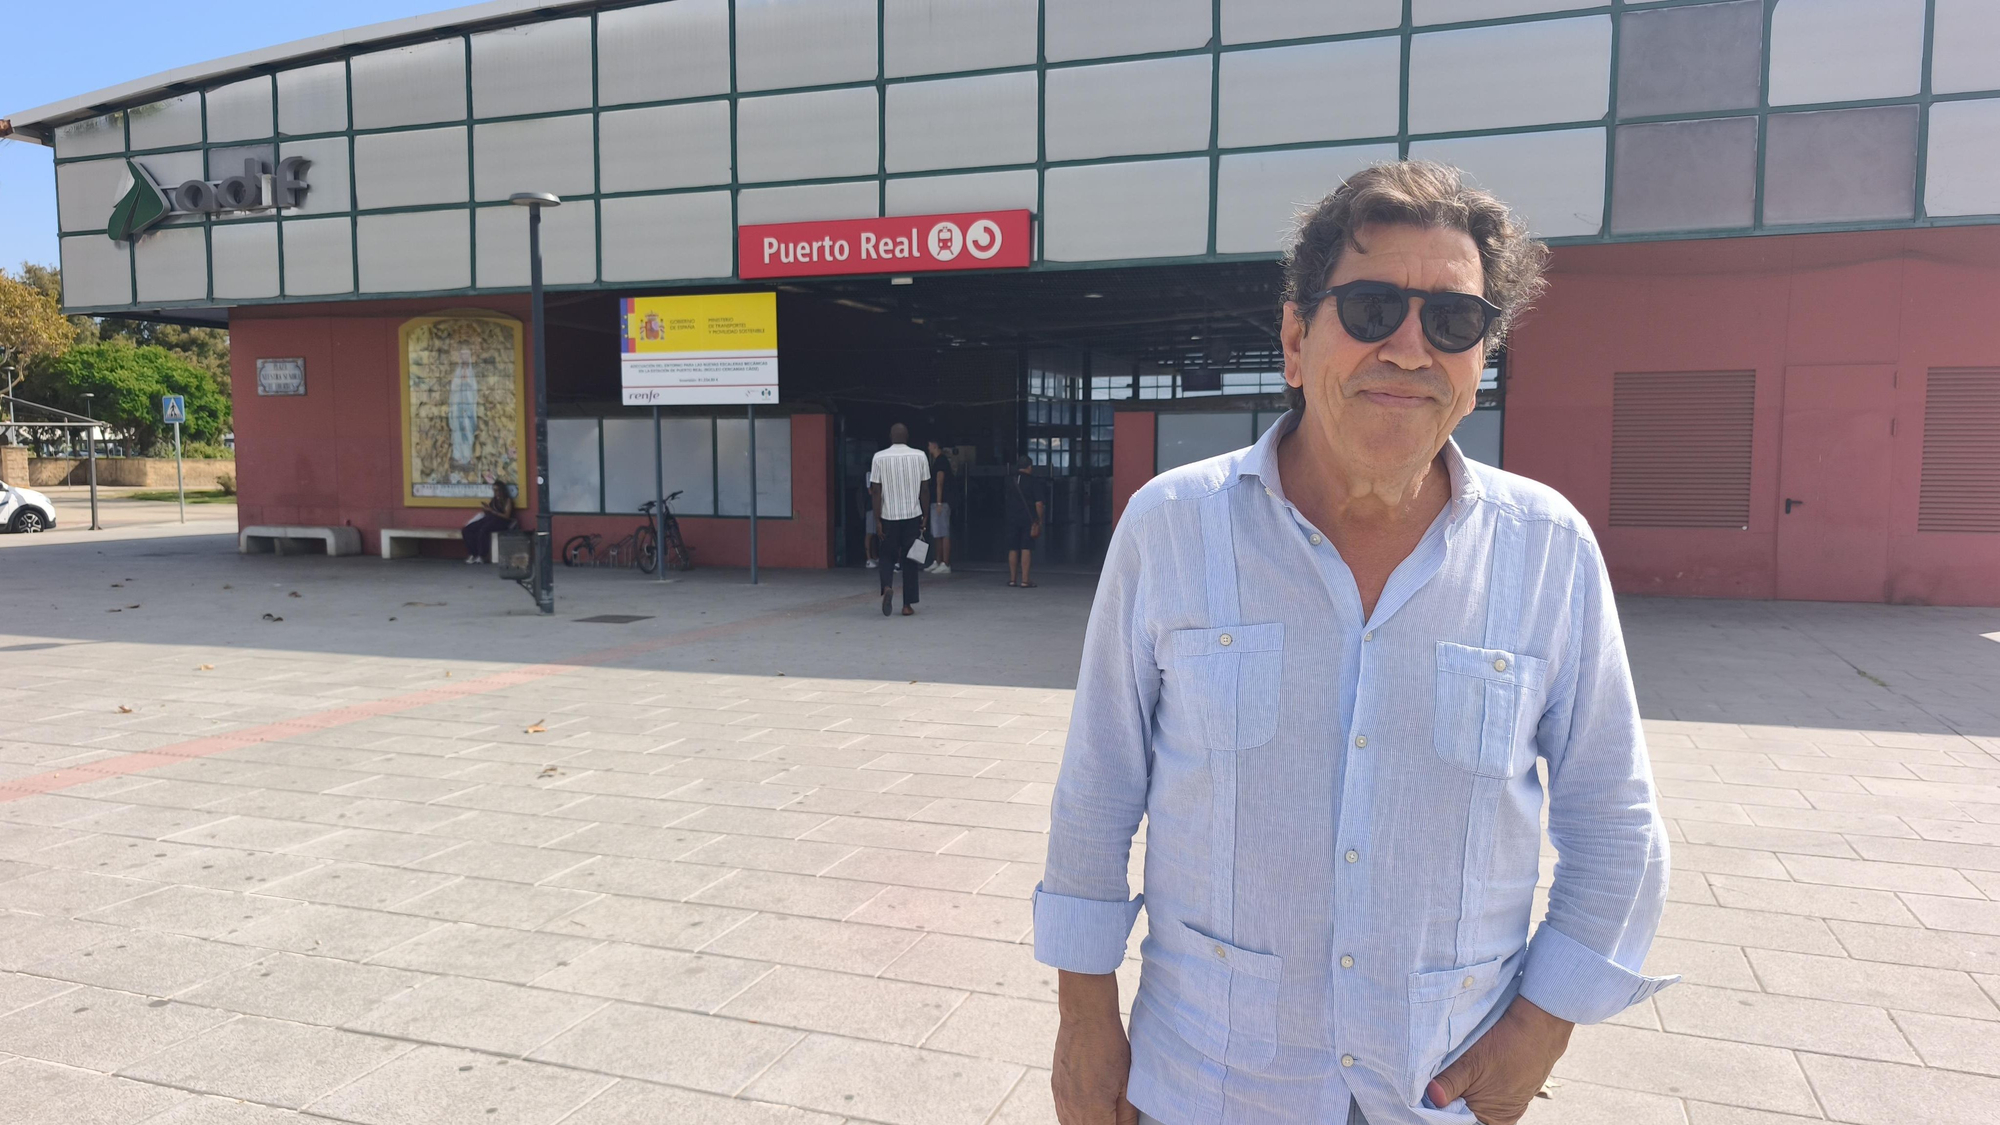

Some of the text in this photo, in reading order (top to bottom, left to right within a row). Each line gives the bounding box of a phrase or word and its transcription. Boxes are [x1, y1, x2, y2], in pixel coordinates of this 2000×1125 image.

[175, 156, 312, 215] adif
[763, 228, 921, 264] Puerto Real
[629, 389, 660, 403] renfe
